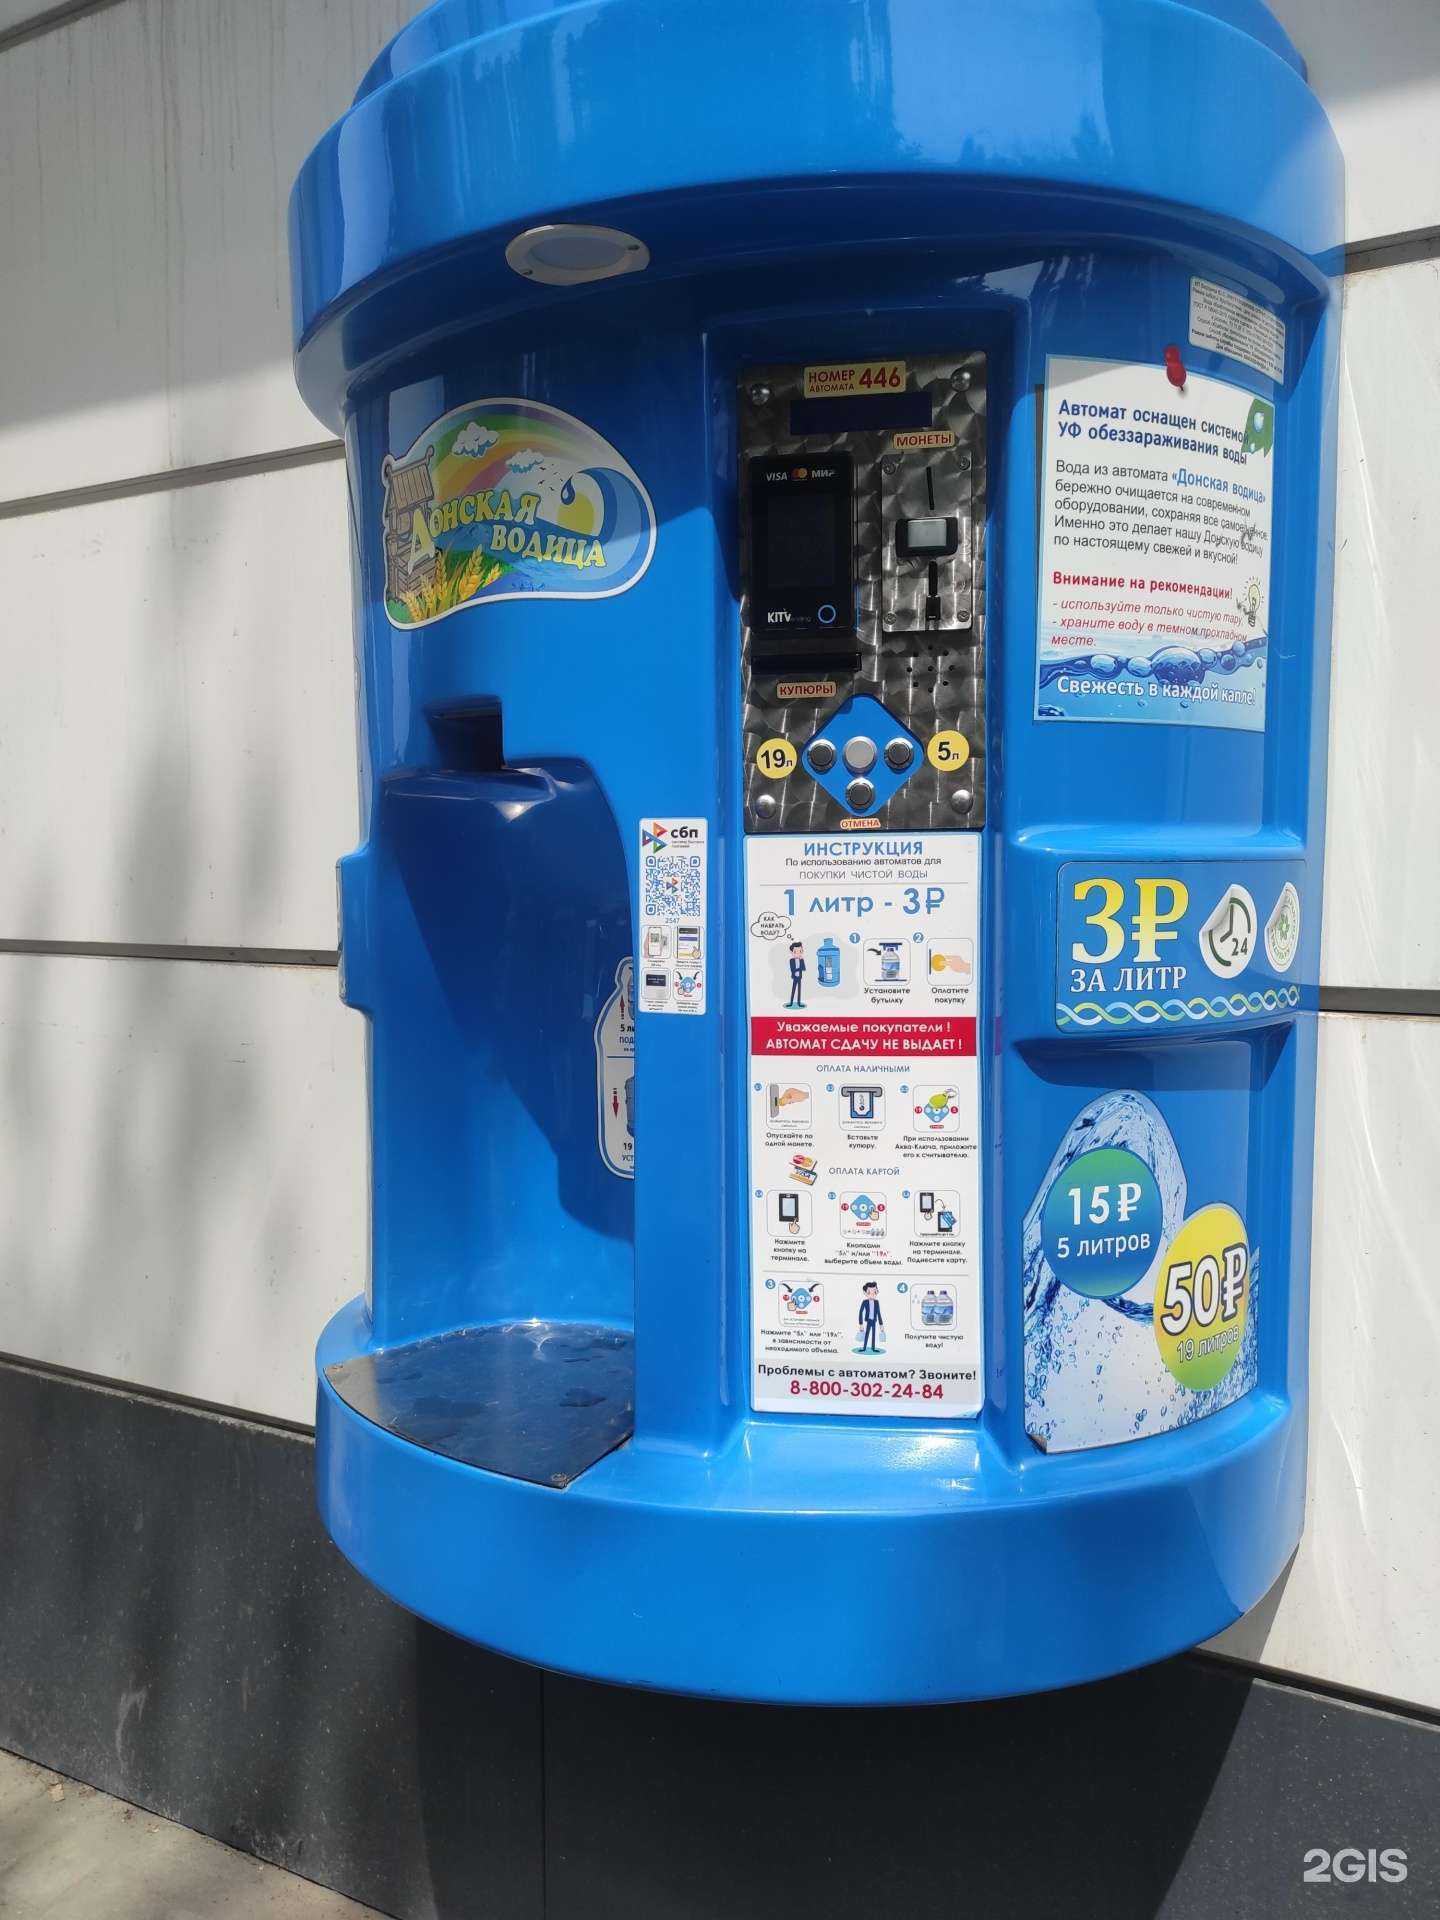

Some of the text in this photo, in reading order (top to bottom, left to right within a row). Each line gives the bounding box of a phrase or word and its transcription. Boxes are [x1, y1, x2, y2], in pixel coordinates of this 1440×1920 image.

[808, 369, 855, 384] НОМЕР
[859, 367, 901, 389] 446
[809, 383, 855, 393] АВТОМАТА
[1058, 399, 1127, 419] Автомат
[1133, 409, 1196, 432] оснащен
[896, 433, 952, 447] МОНЕТЫ
[1058, 421, 1247, 464] УФ обеззараживания воды
[766, 472, 788, 481] VISA
[1056, 459, 1090, 476] Вода
[1094, 465, 1109, 475] из
[1112, 466, 1168, 482] автомата
[1172, 468, 1229, 493] «Донская
[1055, 479, 1251, 517] бережно очищается на современном
[1054, 497, 1148, 518] оборудовании,
[1151, 507, 1201, 525] сохраняя
[1203, 515, 1219, 527] все
[1054, 514, 1105, 530] Именно
[1108, 521, 1129, 532] это
[1131, 523, 1172, 537] делает
[1175, 529, 1202, 544] нашу
[491, 525, 607, 569] ВОДИЦА
[1054, 535, 1070, 546] по
[1073, 536, 1150, 555] настоящему
[1153, 541, 1192, 556] свежей
[1194, 549, 1200, 558] и
[1053, 571, 1233, 600] Внимание на рекомендации!
[1061, 600, 1222, 624] используйте только чистую
[1060, 618, 1115, 631] храните
[1118, 620, 1145, 634] воду
[1147, 623, 1154, 632] в
[1157, 623, 1200, 635] темном
[1051, 634, 1097, 647] месте.
[779, 684, 834, 696] КУПЮРЫ
[1057, 676, 1257, 706] Свежесть в каждой капле!
[841, 819, 880, 829] ОТМЕНА
[803, 841, 924, 857] ИНСТРУКЦИЯ
[785, 858, 942, 867] По использованию автоматов для
[799, 868, 928, 880] ПОКУПКИ ЧИСТОЙ ВОДЫ
[783, 888, 796, 916] 1
[809, 895, 874, 917] литр
[1231, 938, 1248, 956] 24
[1070, 966, 1187, 993] ЗА ЛИТР
[864, 987, 911, 995] Установите
[931, 987, 969, 995] Оплатите
[871, 996, 904, 1004] бутылку
[934, 996, 966, 1004] покупку
[620, 1024, 626, 1032] 5
[777, 1021, 859, 1033] Уважаемые
[861, 1022, 943, 1034] покупатели
[766, 1038, 827, 1049] АВТОМАТ
[830, 1038, 878, 1050] СДАЧУ
[883, 1038, 900, 1050] НЕ
[902, 1038, 955, 1051] ВЫДАЕТ
[816, 1064, 911, 1073] ОПЛАТА НАЛИЧНЫМИ
[623, 1142, 632, 1150] 19
[828, 1166, 900, 1176] ОПЛАТА КАРТОЙ
[1057, 1232, 1151, 1259] 5 литров
[1176, 1326, 1240, 1363] 19 литров
[758, 1364, 976, 1380] Проблемы с автоматом? Звоните!
[790, 1380, 944, 1400] 8-800-302-24-84
